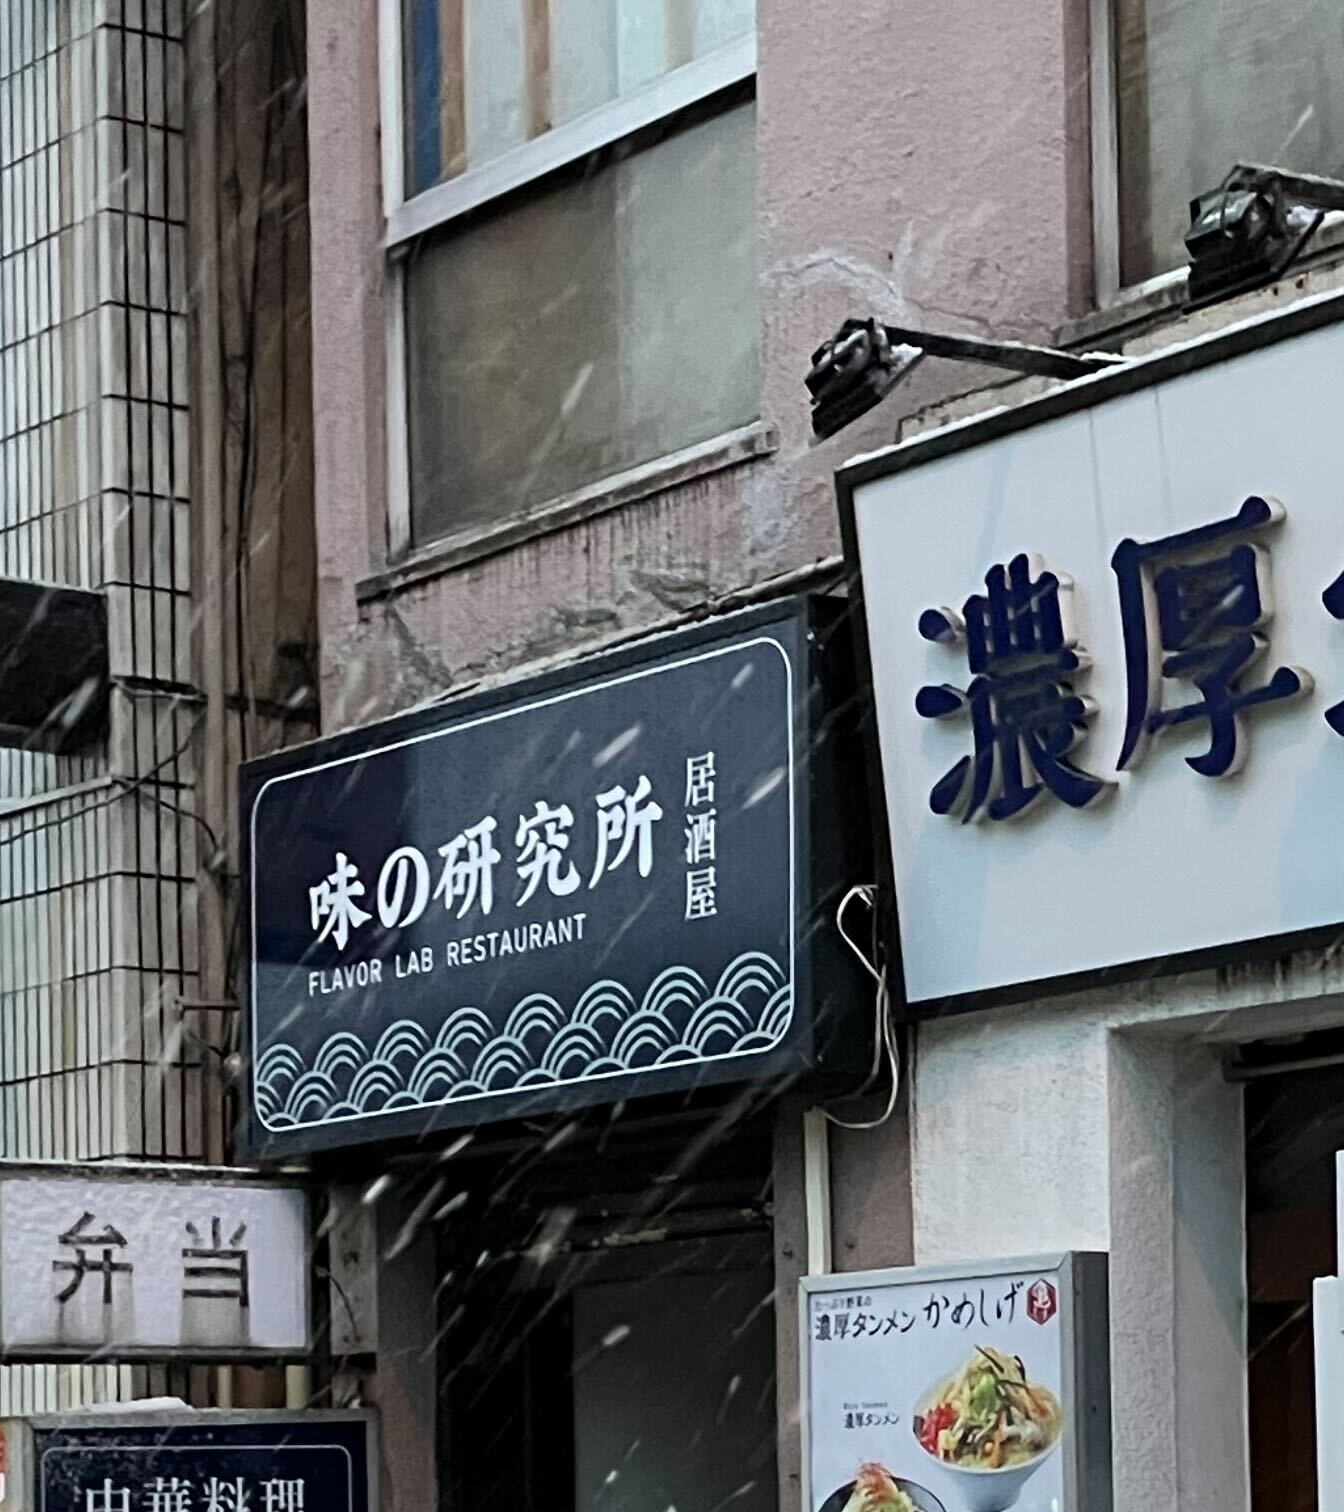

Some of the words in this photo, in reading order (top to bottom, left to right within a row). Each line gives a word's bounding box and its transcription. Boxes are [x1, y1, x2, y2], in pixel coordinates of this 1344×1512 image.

[308, 775, 663, 951] 味の研究所
[684, 751, 717, 923] 居酒屋
[308, 957, 382, 997] FLAVOR
[395, 949, 434, 980] LAB
[446, 913, 587, 968] RESTAURANT
[52, 1211, 251, 1306] 弁当
[815, 1309, 916, 1341] 濃厚タンメン
[923, 1282, 1024, 1330] かめしげ
